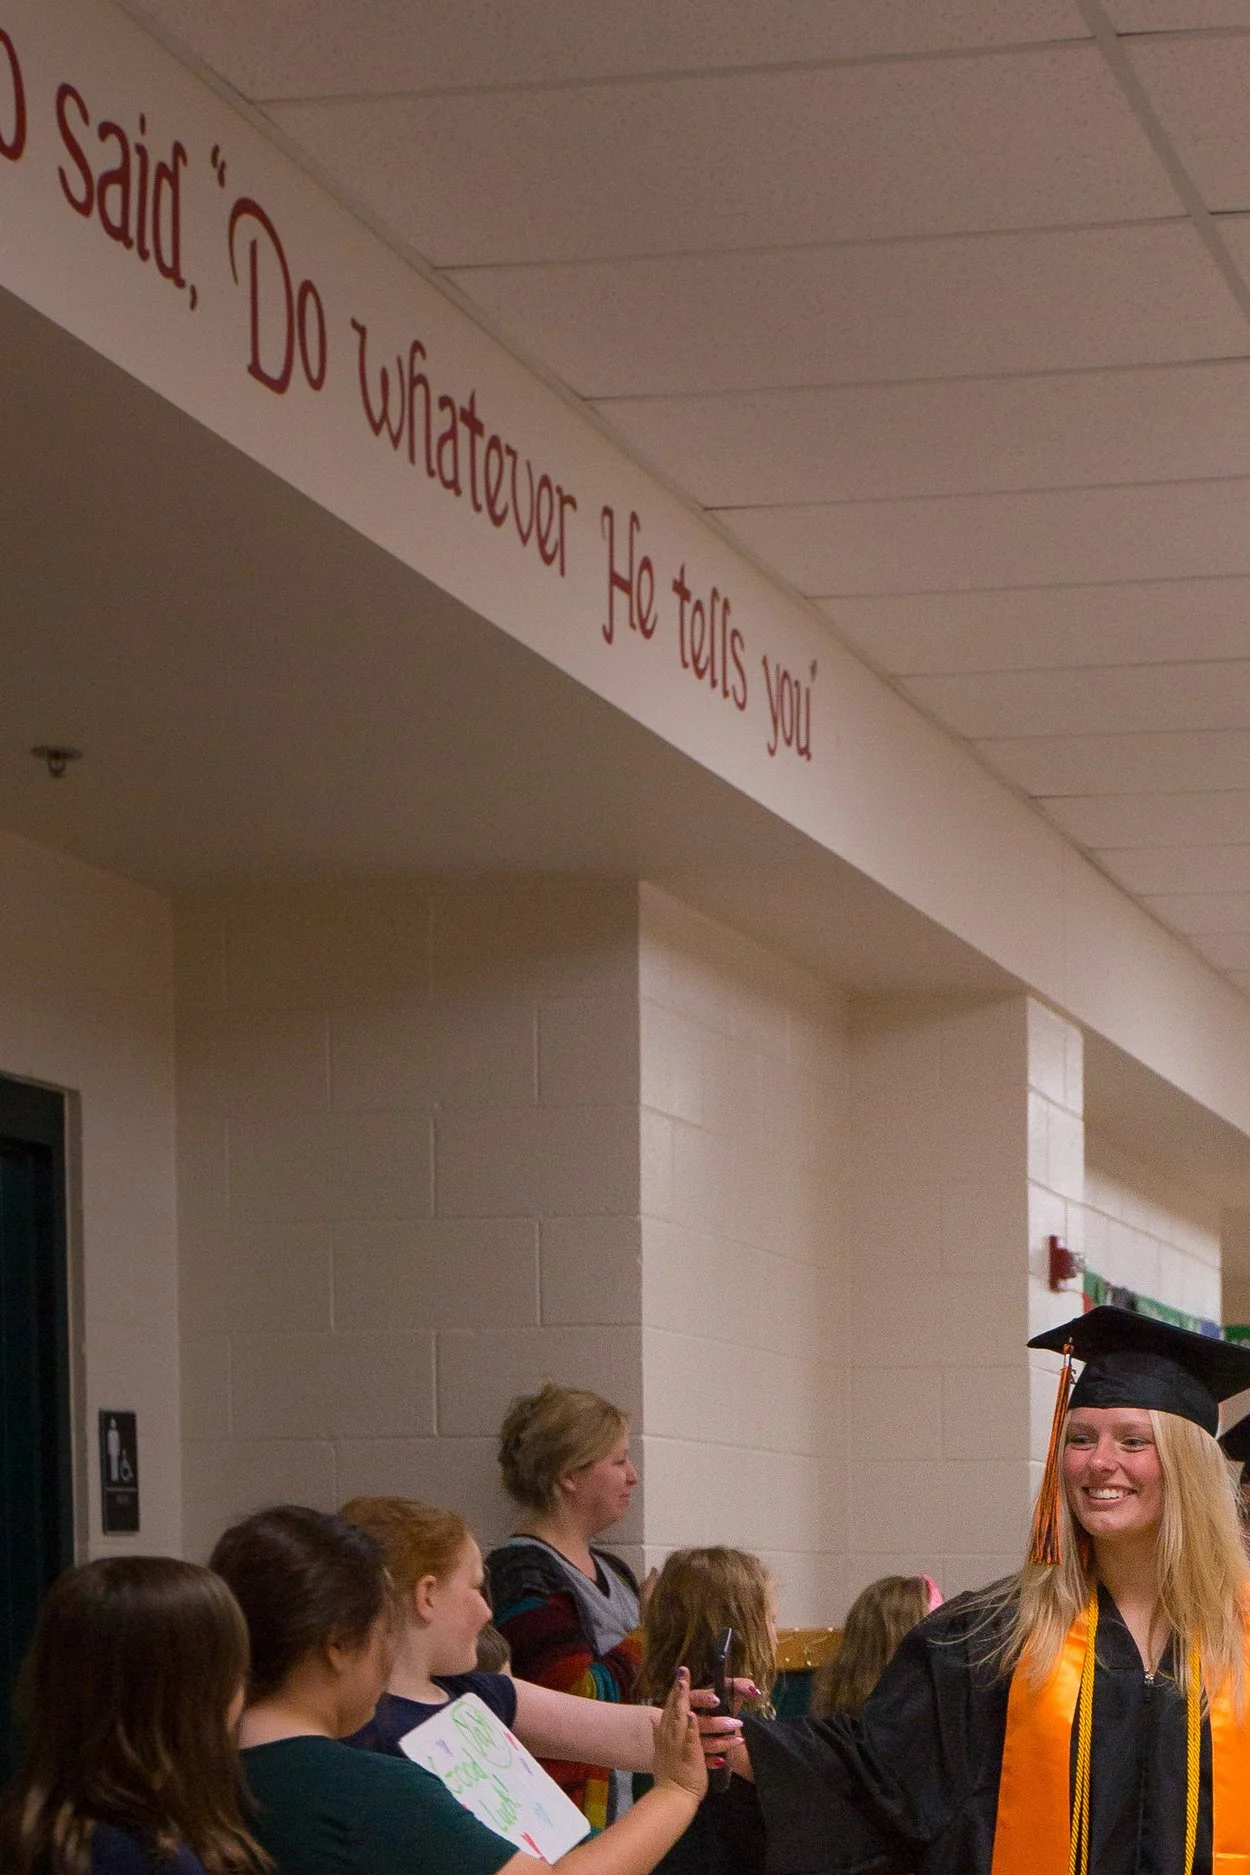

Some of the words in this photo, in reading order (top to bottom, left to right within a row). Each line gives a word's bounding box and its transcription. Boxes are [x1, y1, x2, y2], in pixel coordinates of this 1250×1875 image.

[56, 82, 198, 311] said,
[351, 317, 577, 578] whatever
[601, 504, 658, 645] He
[671, 562, 748, 712] tells
